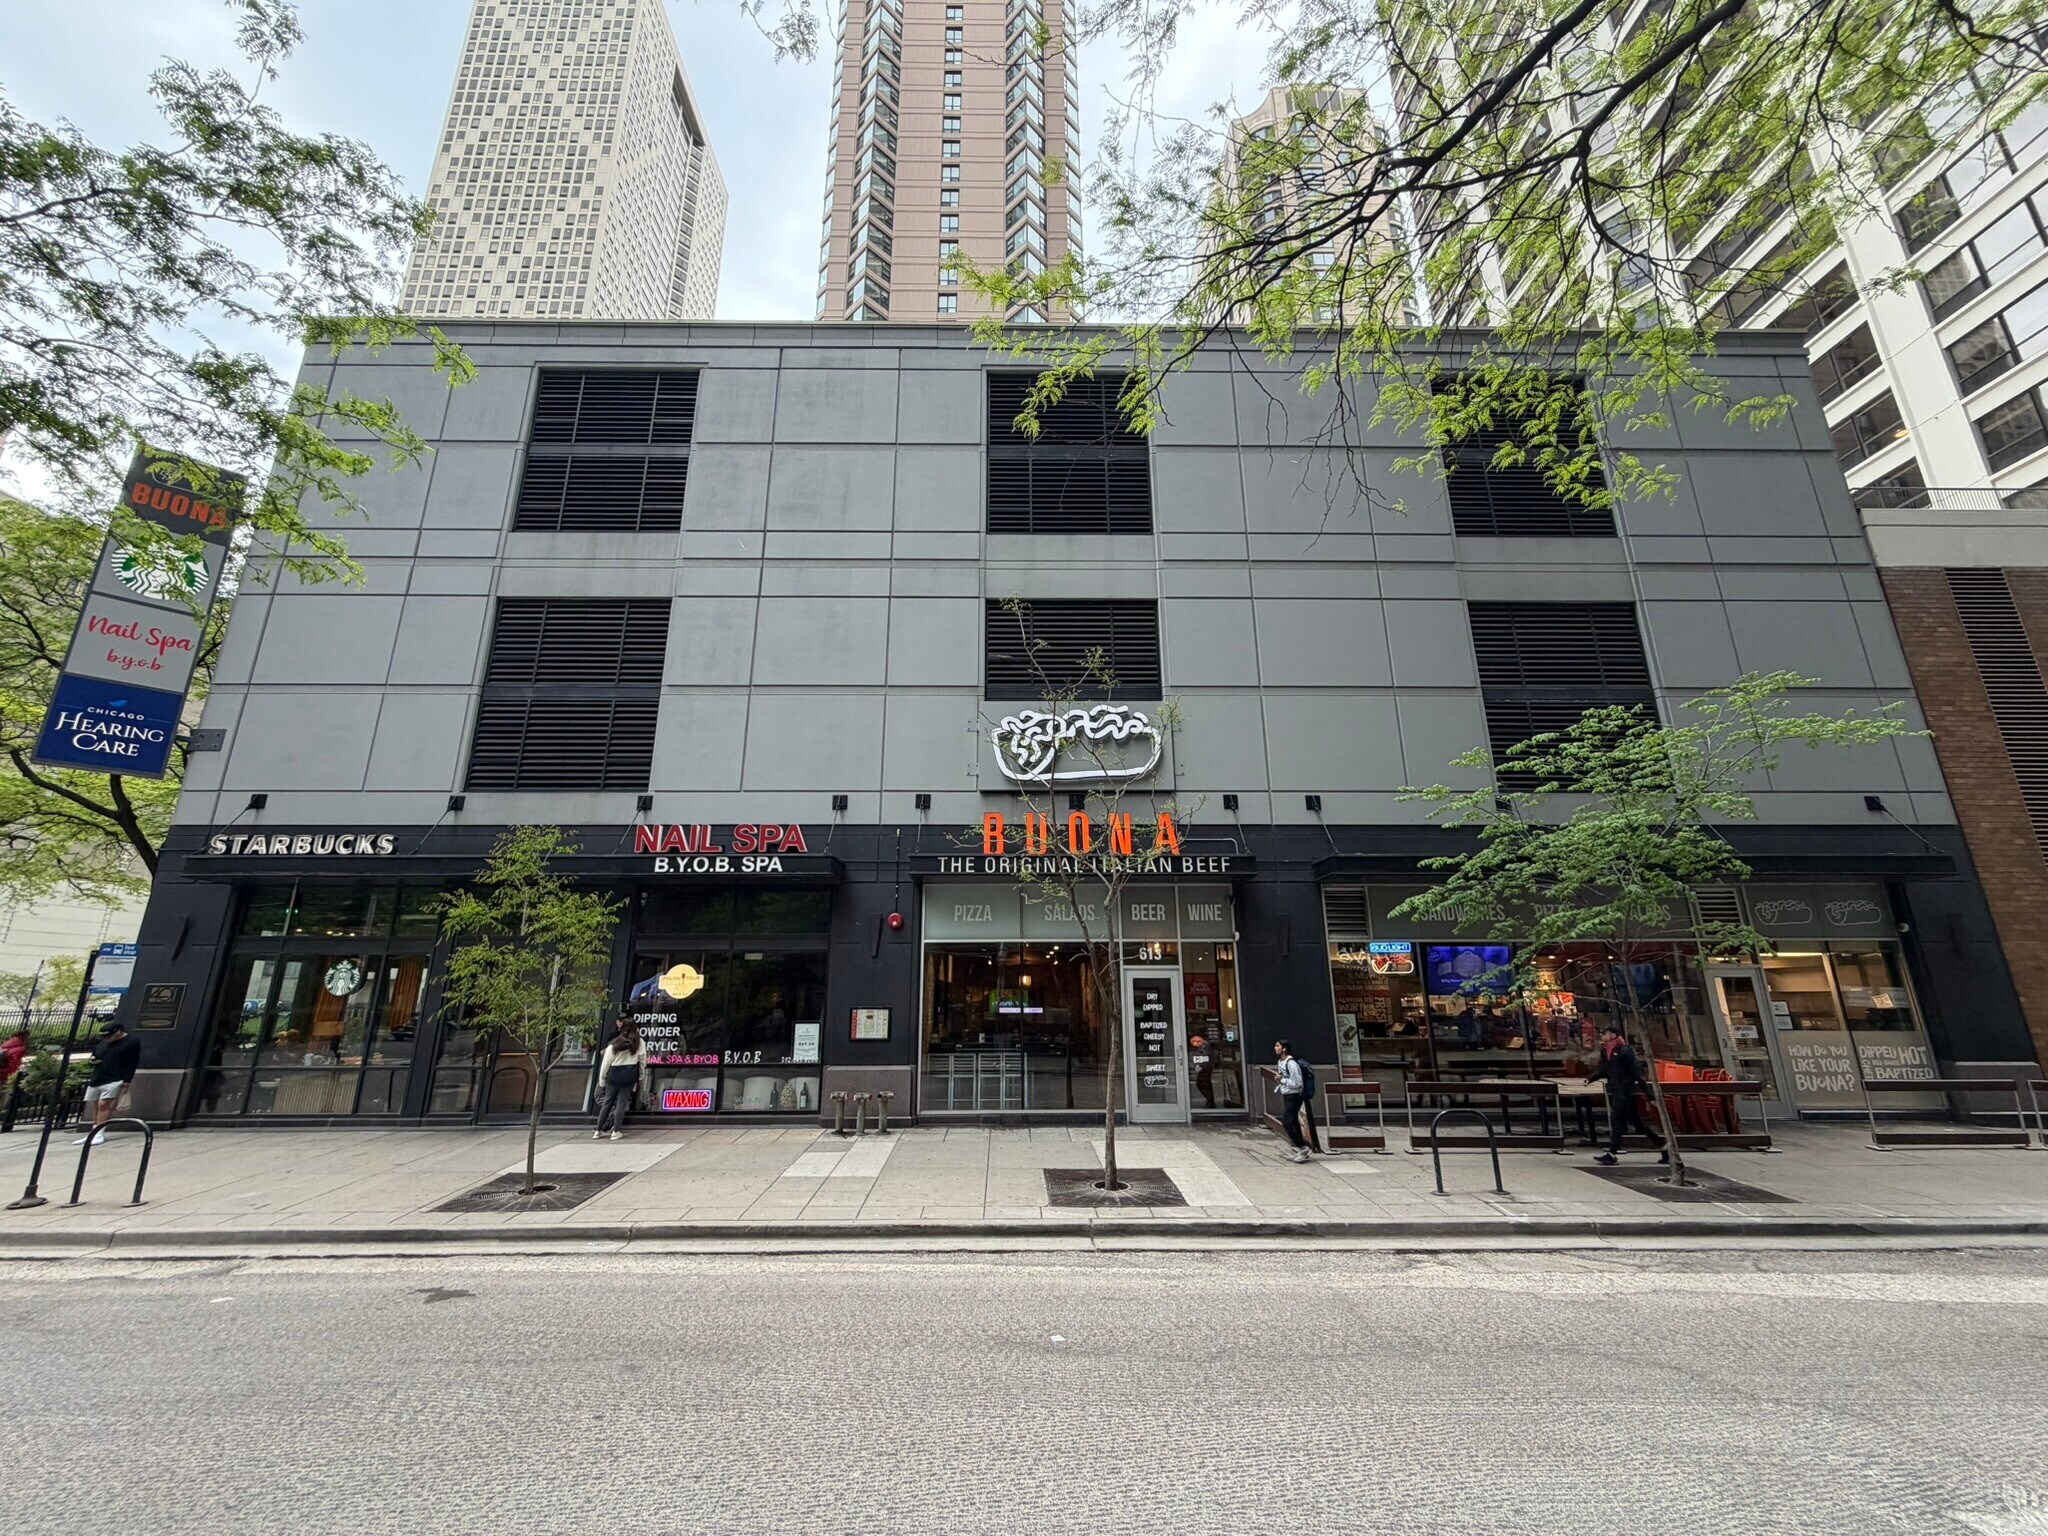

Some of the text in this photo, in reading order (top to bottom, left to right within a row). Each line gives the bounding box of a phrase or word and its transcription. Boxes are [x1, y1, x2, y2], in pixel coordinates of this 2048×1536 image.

[132, 482, 228, 528] BUONA
[87, 615, 194, 656] Nail Spa
[107, 649, 164, 671] b.y.o.b
[87, 706, 145, 721] CHICAGO
[55, 712, 164, 743] HEARING
[71, 733, 140, 758] CARE
[634, 824, 808, 853] NAIL SPA
[983, 811, 1180, 855] BUONA
[208, 834, 396, 855] STARBUCKS
[654, 856, 783, 873] B.Y.O.B. SPA
[937, 857, 975, 873] THE
[984, 857, 1083, 873] ORIGINAL
[1184, 857, 1231, 873] BEEF
[954, 904, 1222, 922] PIZZA SALADS BEER WINE
[633, 1013, 677, 1023] DIPPING
[637, 1027, 680, 1036] OWDER
[646, 1041, 678, 1051] RYLIC
[1788, 1045, 1812, 1057] HOW
[666, 1055, 683, 1063] SPA
[684, 1055, 691, 1063] &
[693, 1055, 719, 1064] BYOB
[724, 1050, 762, 1063] B.Y.O.B
[1859, 1045, 1927, 1065] DIPPED HOT
[1146, 1064, 1165, 1072] SWEET
[1820, 1058, 1853, 1072] YOUR
[666, 1092, 709, 1107] WAXING
